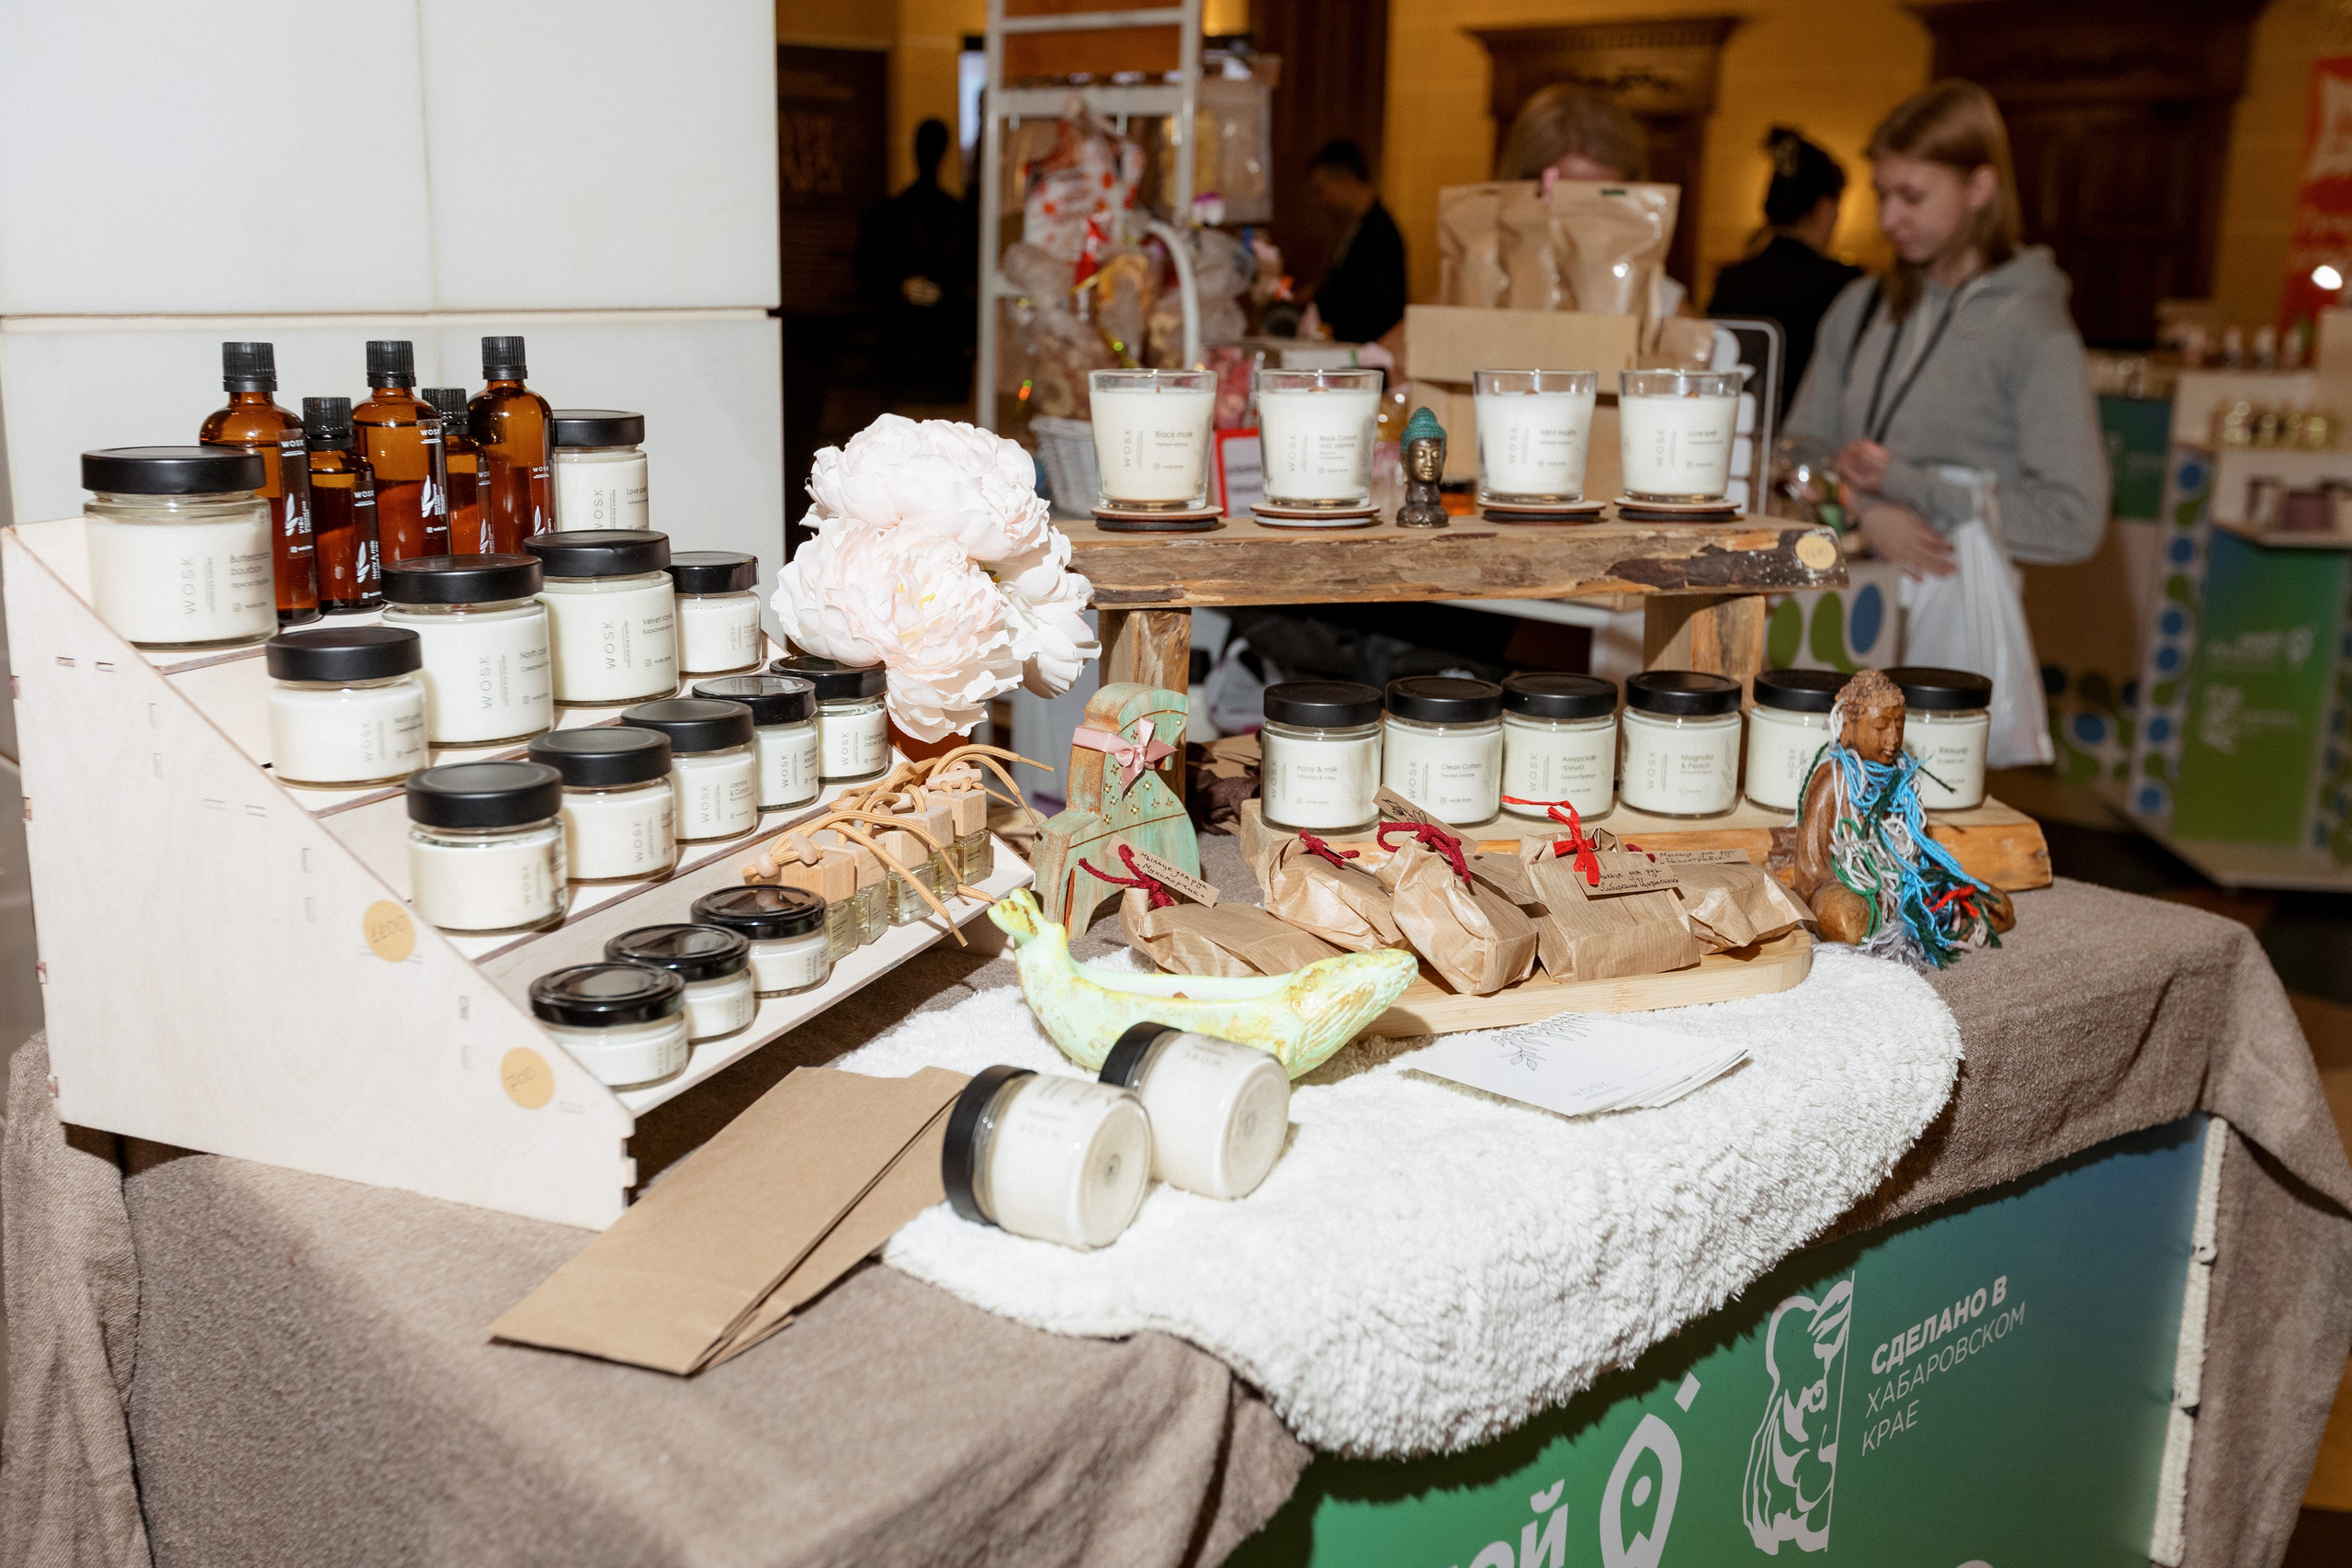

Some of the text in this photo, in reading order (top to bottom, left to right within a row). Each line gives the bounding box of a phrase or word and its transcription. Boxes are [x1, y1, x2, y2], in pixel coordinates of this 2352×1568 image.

[1123, 428, 1131, 468] WOSK
[1155, 430, 1175, 438] Black
[603, 620, 616, 671] WOSK
[479, 655, 493, 710] WOSK
[841, 731, 849, 767] WOSK
[1296, 764, 1316, 773] Hony
[1562, 755, 1597, 763] Амурская
[1680, 753, 1714, 762] Magnolia
[780, 753, 789, 789] WOSK
[1408, 761, 1418, 799] WOSK
[1529, 753, 1539, 792] WOSK
[1646, 751, 1656, 790] WOSK
[700, 784, 710, 824] WOSK
[1871, 1275, 2008, 1376] СДЕЛАНО В
[1865, 1301, 2026, 1420] ХАБАРОВСКОМ
[1861, 1399, 1920, 1457] КРАЕ
